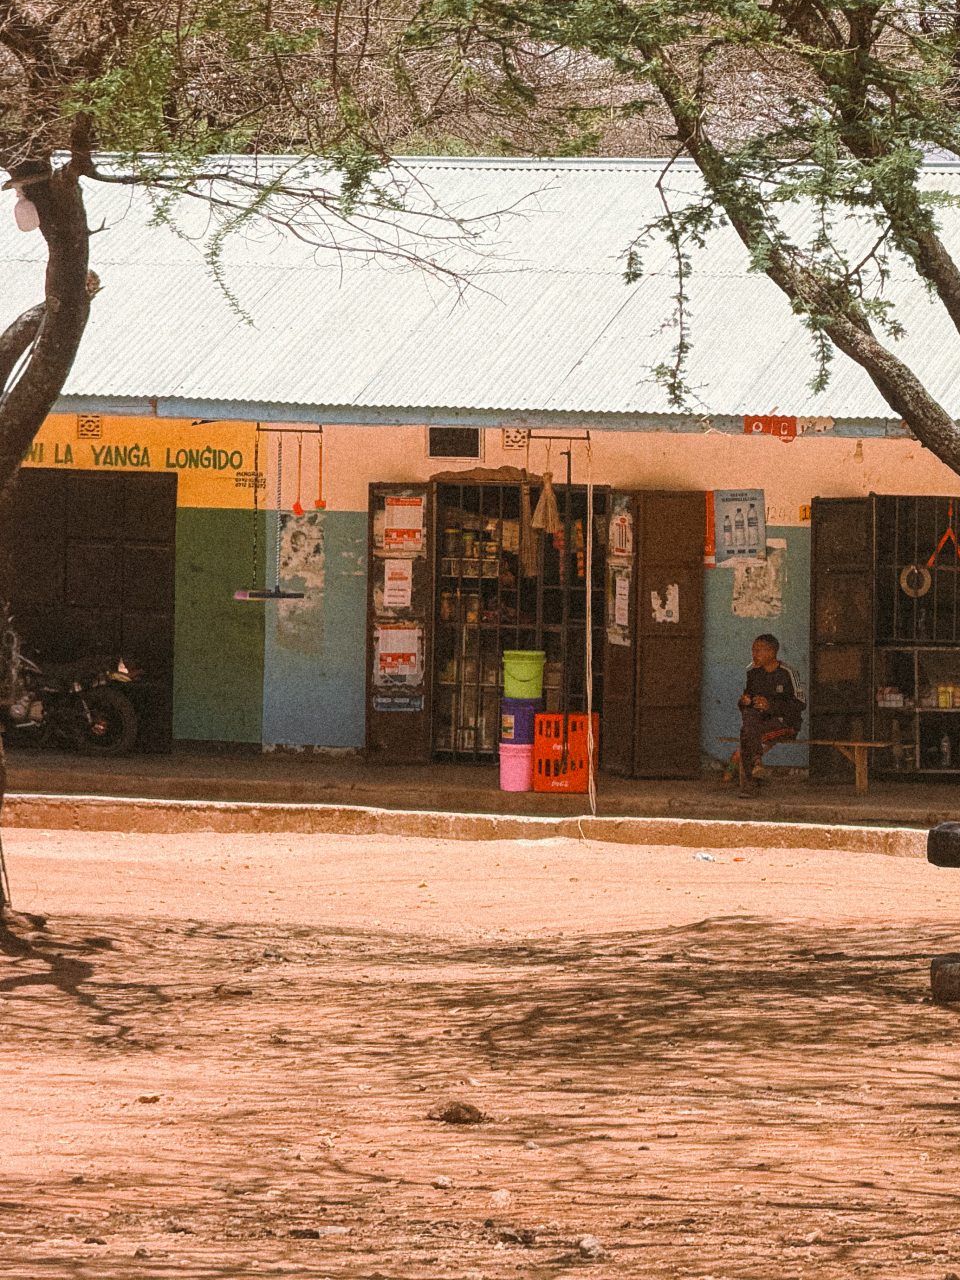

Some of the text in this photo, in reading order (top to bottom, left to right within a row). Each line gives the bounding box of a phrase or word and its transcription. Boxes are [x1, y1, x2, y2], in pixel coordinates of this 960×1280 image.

[54, 443, 74, 464] LA
[90, 443, 150, 467] YANGA
[165, 446, 244, 470] LONGIDO
